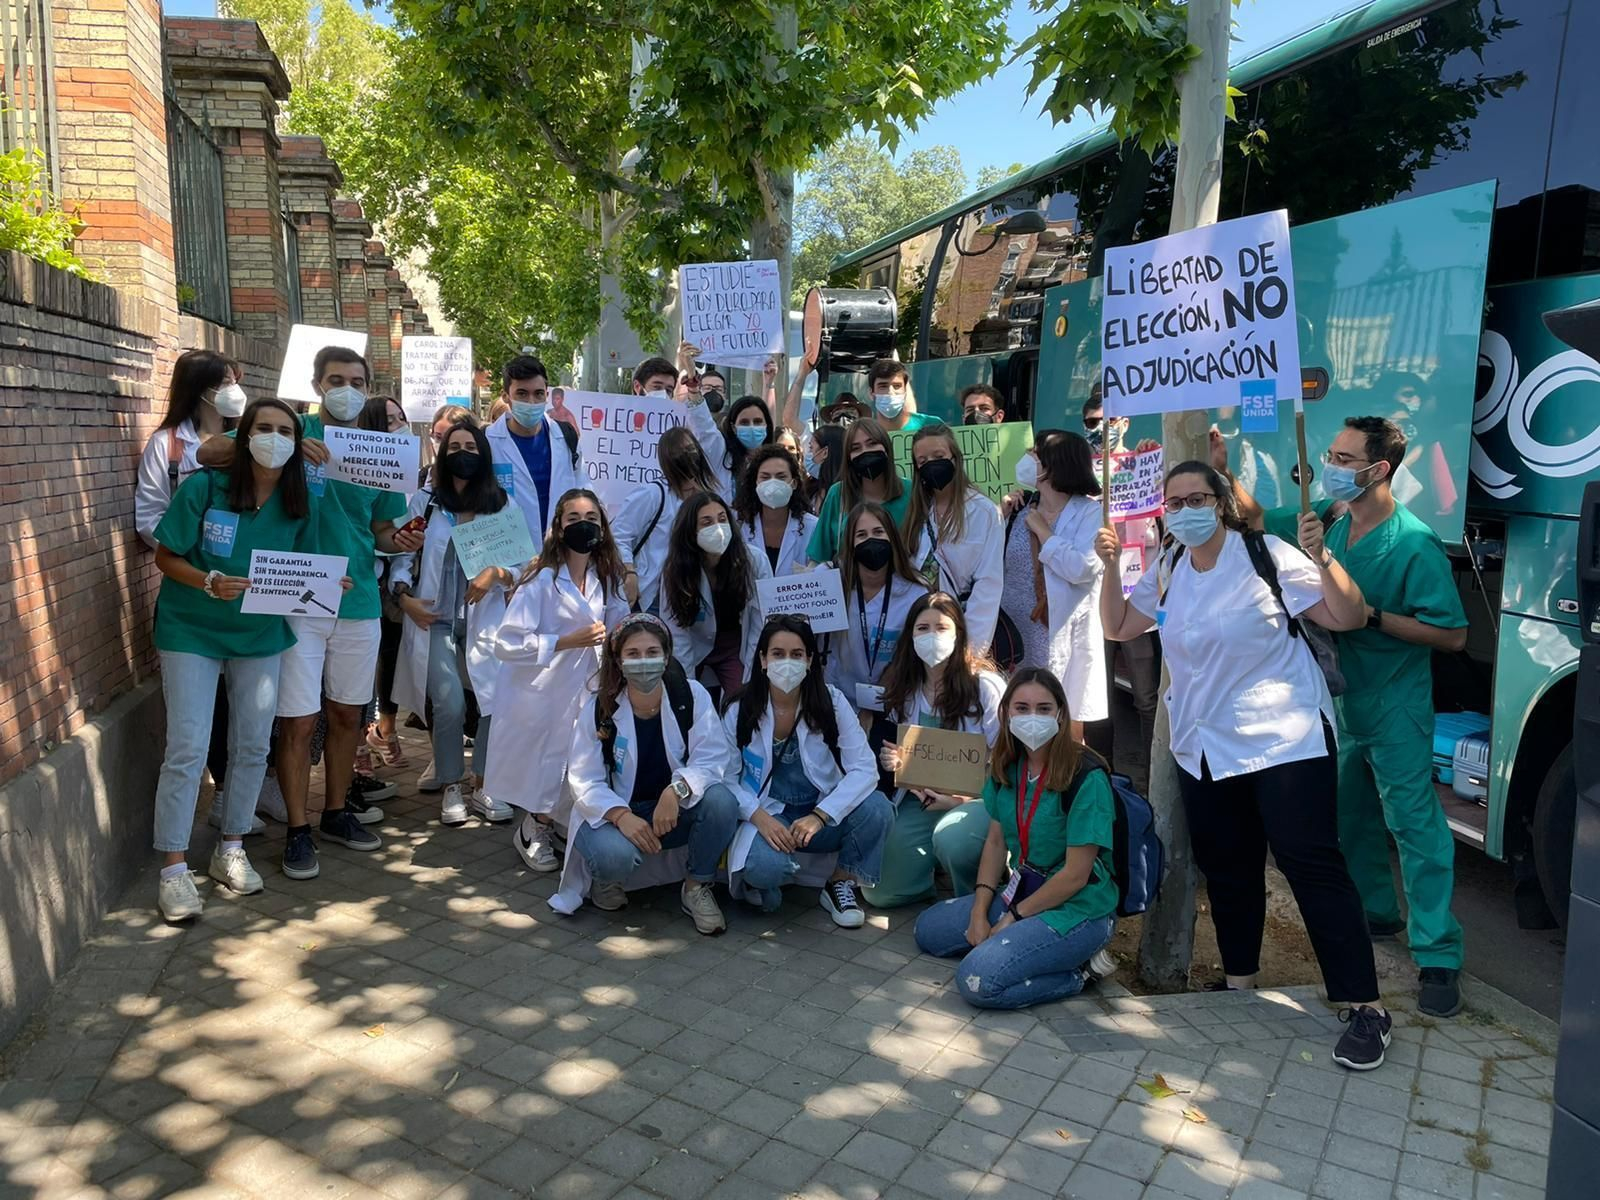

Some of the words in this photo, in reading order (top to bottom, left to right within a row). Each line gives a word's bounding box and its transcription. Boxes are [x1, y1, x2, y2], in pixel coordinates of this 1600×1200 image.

[1366, 34, 1384, 48] SALIDA
[1384, 31, 1391, 42] DE
[1391, 18, 1422, 38] EMERGENCIA
[1238, 240, 1279, 278] DE
[685, 263, 755, 291] ESTUDIÉ
[686, 293, 712, 312] MUY
[716, 293, 749, 312] DURO
[750, 290, 776, 311] PARA
[1222, 276, 1288, 329] NO
[690, 313, 736, 332] ELEGIR
[744, 312, 761, 330] YO
[722, 332, 768, 350] FUTURO
[439, 378, 455, 386] QUE
[1242, 395, 1274, 409] FSE
[1242, 408, 1274, 417] UNIDA
[346, 432, 382, 442] FUTURO
[348, 443, 396, 455] SANIDAD
[598, 437, 620, 455] EL
[343, 456, 378, 466] MERECE
[381, 459, 400, 468] UNA
[1140, 452, 1160, 466] HAY
[304, 464, 325, 478] SE
[338, 465, 390, 478] ELECCIÓN
[585, 461, 609, 481] OR
[1139, 468, 1150, 478] EN
[351, 478, 391, 489] CALIDAD
[497, 474, 512, 483] SE
[1110, 479, 1151, 494] ERRAZAS
[204, 521, 234, 538] FSE
[260, 588, 300, 596] SENTENCIA
[776, 583, 803, 593] ERROR
[767, 605, 792, 613] JUSTA"
[811, 599, 838, 607] FOUND
